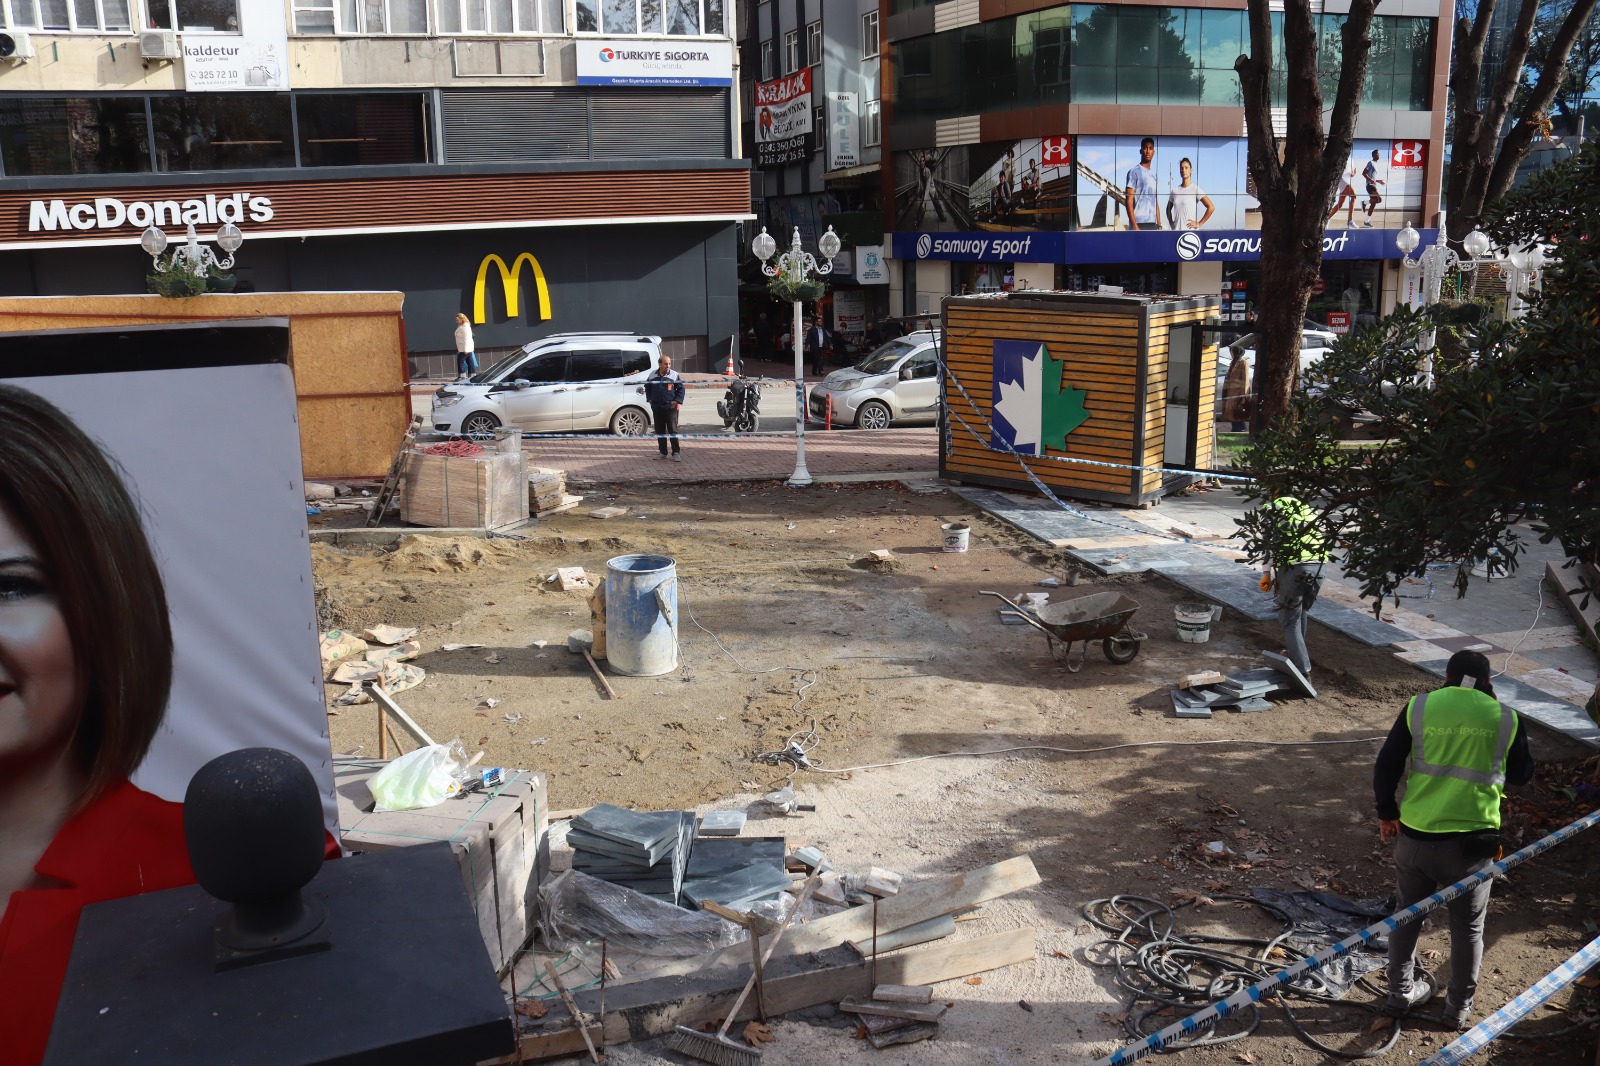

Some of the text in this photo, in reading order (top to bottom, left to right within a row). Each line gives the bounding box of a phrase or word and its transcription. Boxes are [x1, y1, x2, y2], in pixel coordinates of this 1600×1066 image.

[184, 45, 240, 56] kaldetur
[616, 50, 709, 61] TÜRKİYE SİGORTA
[199, 71, 214, 79] 325
[228, 70, 238, 78] 10
[28, 193, 274, 231] McDonald's
[934, 236, 1031, 259] samuray sport
[1204, 238, 1262, 253] samu
